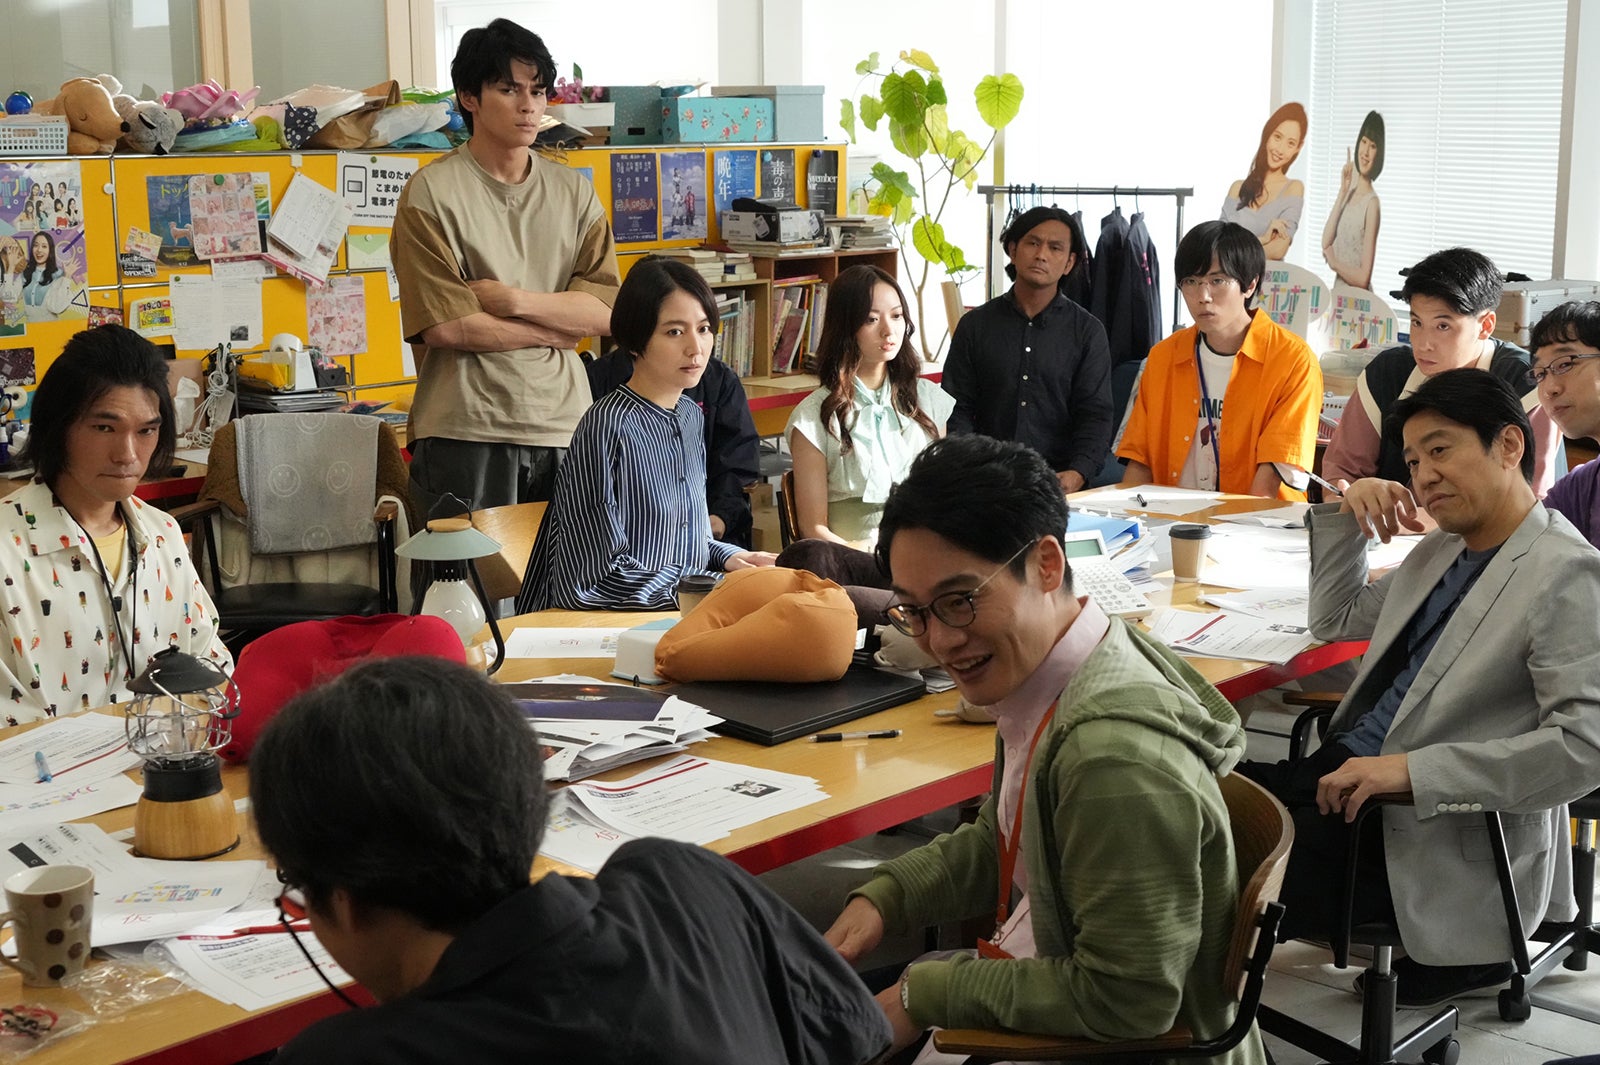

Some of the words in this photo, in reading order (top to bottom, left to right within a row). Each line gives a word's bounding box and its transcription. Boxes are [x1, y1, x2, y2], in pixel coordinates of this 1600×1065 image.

[717, 156, 733, 201] 晩年
[770, 158, 786, 199] 毒の声
[372, 197, 399, 207] 電源オ
